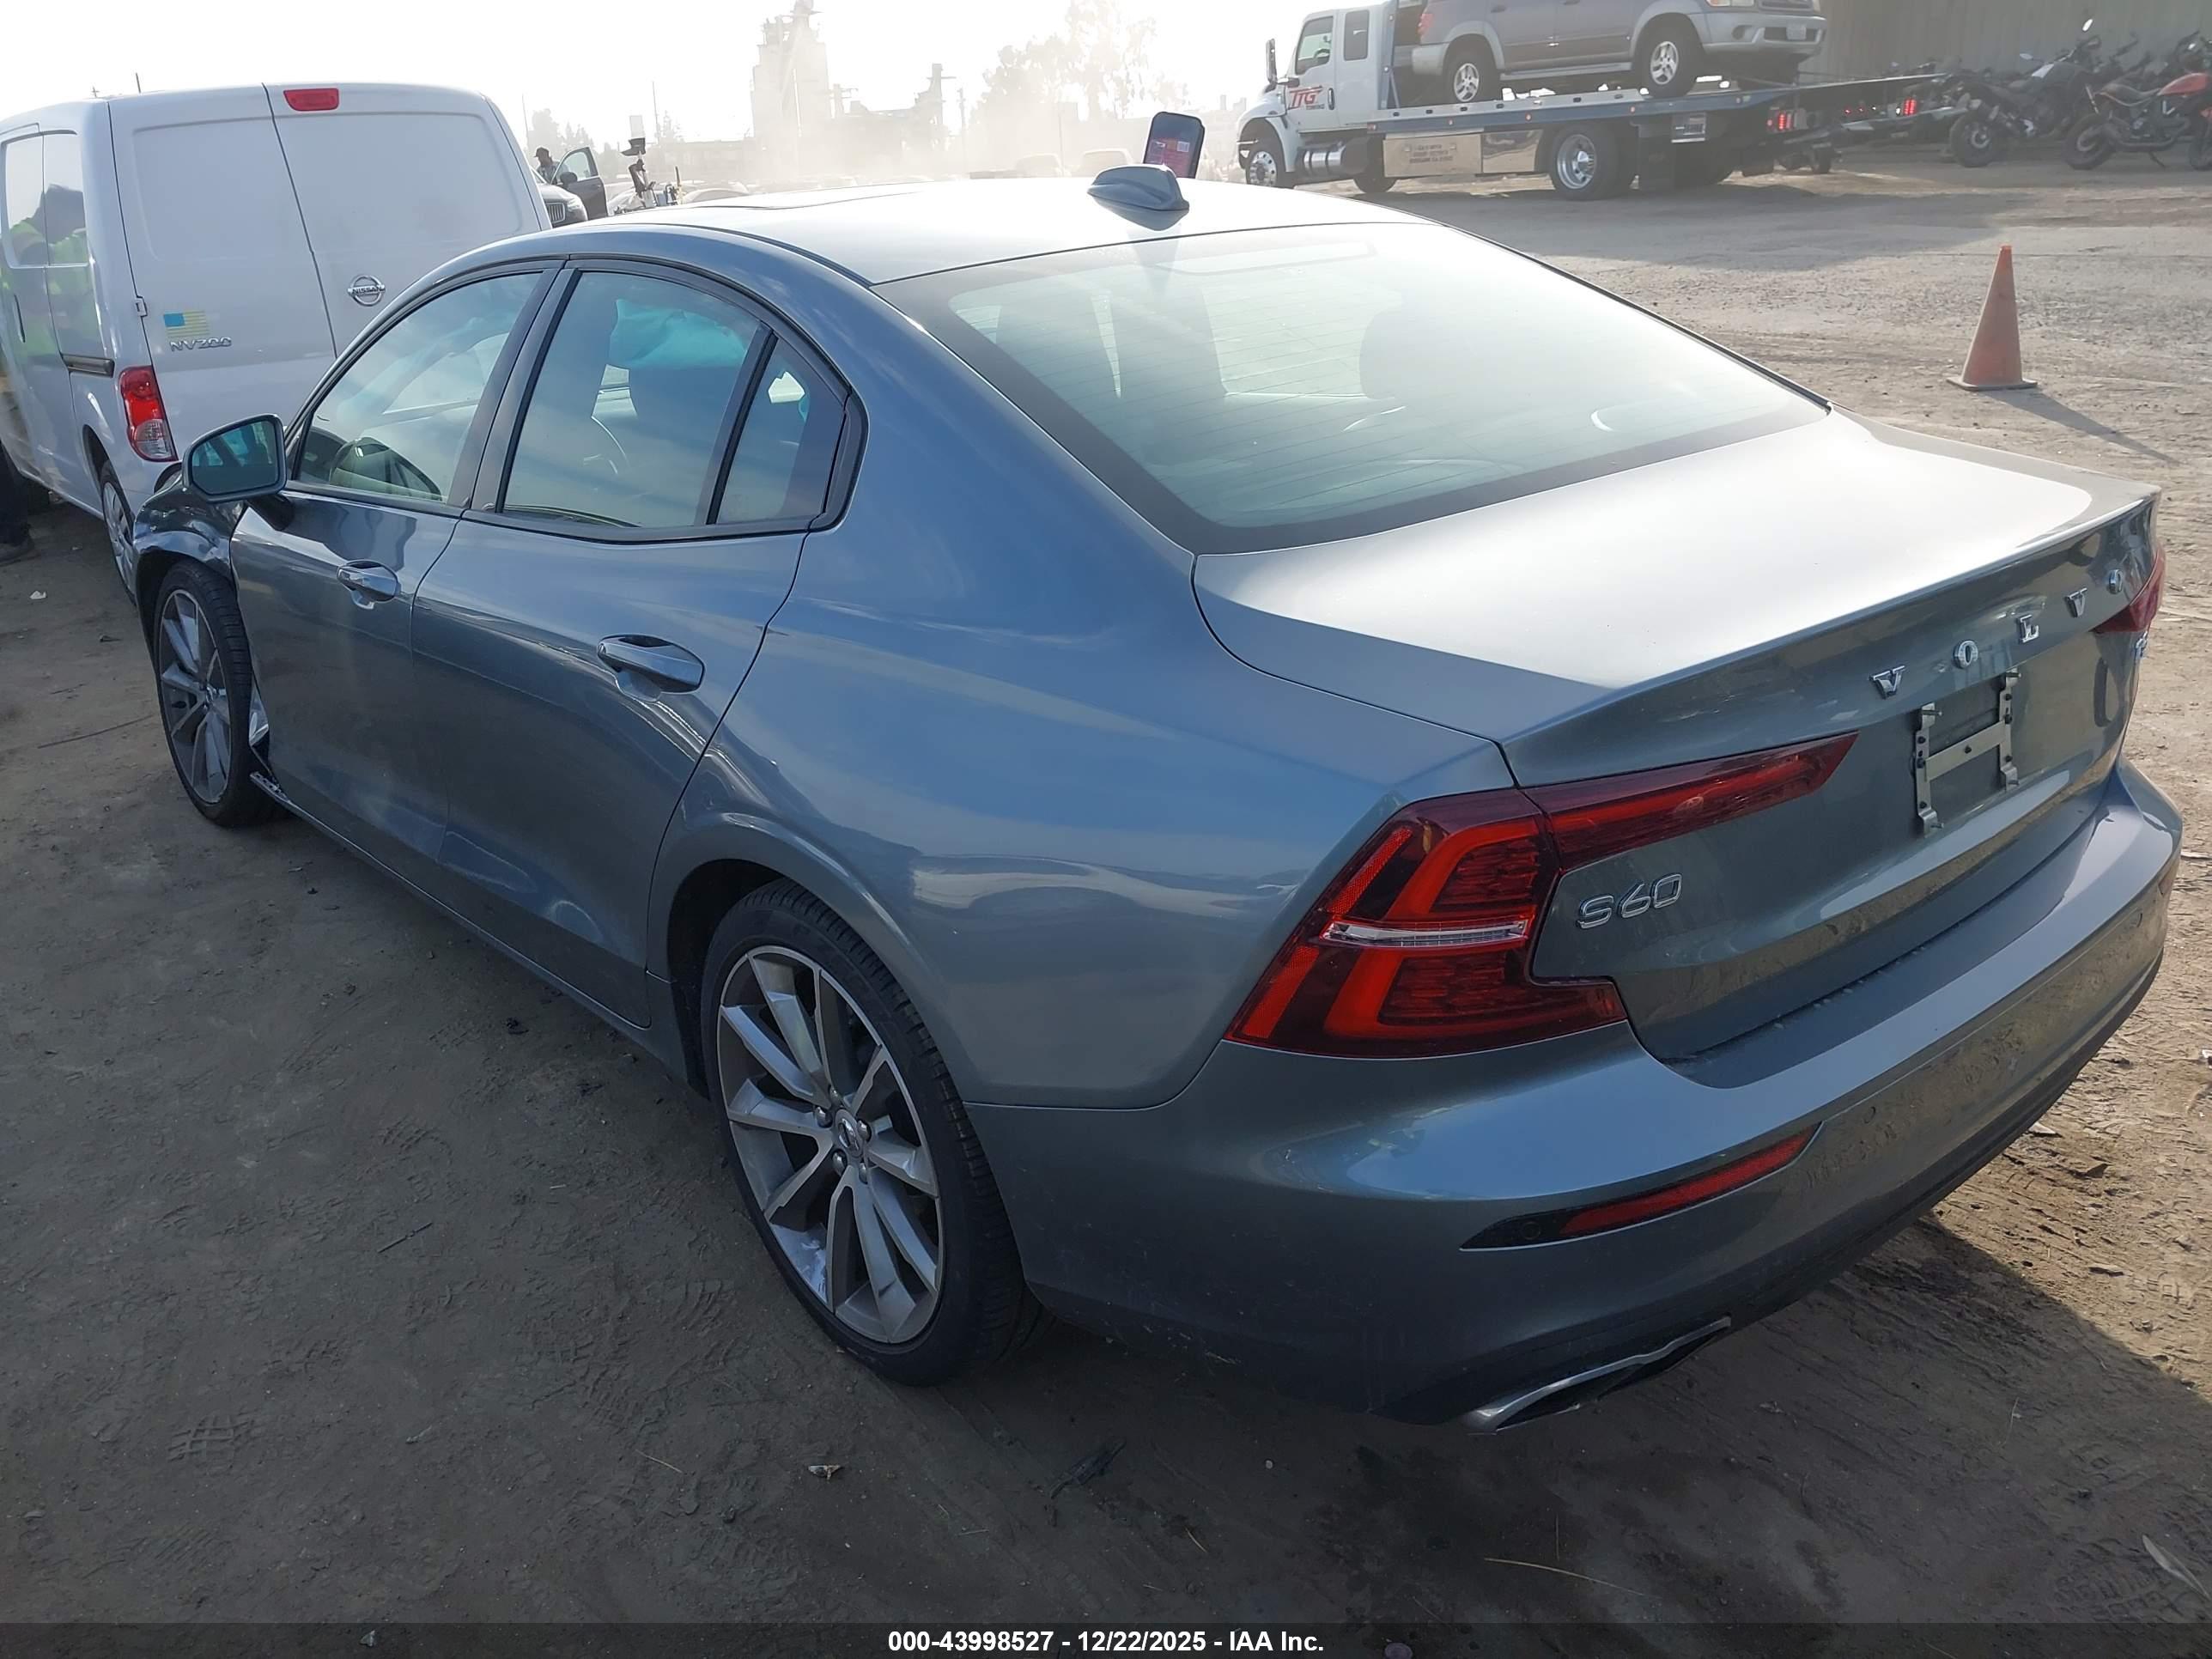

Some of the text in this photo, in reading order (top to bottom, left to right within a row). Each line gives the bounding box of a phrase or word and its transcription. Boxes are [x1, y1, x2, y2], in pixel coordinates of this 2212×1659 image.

[170, 337, 232, 352] NV200
[1869, 568, 2123, 699] VOLVO
[1576, 872, 1682, 929] S60
